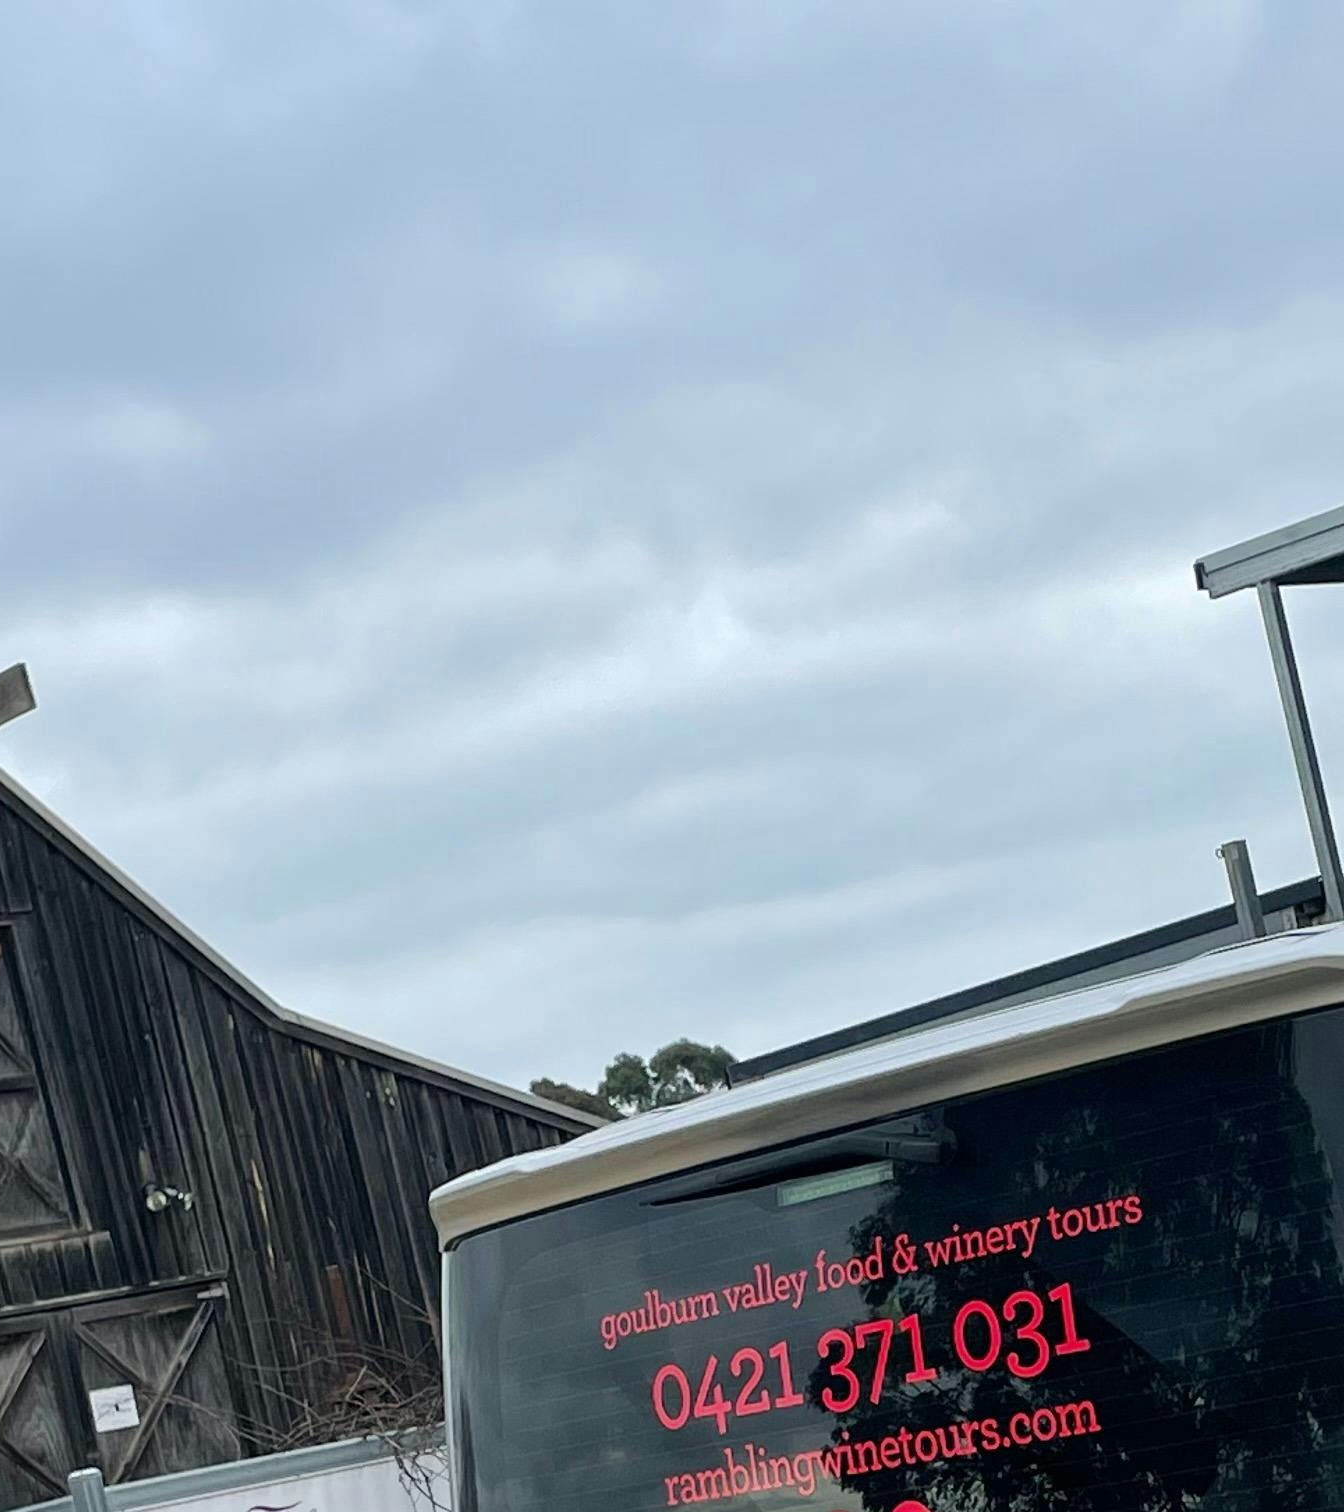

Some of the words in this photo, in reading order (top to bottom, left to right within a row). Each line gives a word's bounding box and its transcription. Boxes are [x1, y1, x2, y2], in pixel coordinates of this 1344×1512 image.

[601, 1288, 720, 1350] goulburn
[723, 1263, 808, 1309] valley
[815, 1235, 884, 1292] food
[892, 1233, 919, 1275] &
[924, 1223, 1041, 1268] winery
[1046, 1194, 1143, 1241] tours
[651, 1339, 804, 1435] 0421
[817, 1313, 939, 1413] 371
[953, 1282, 1091, 1378] 031
[664, 1400, 1102, 1507] ramblingwinetours.com
